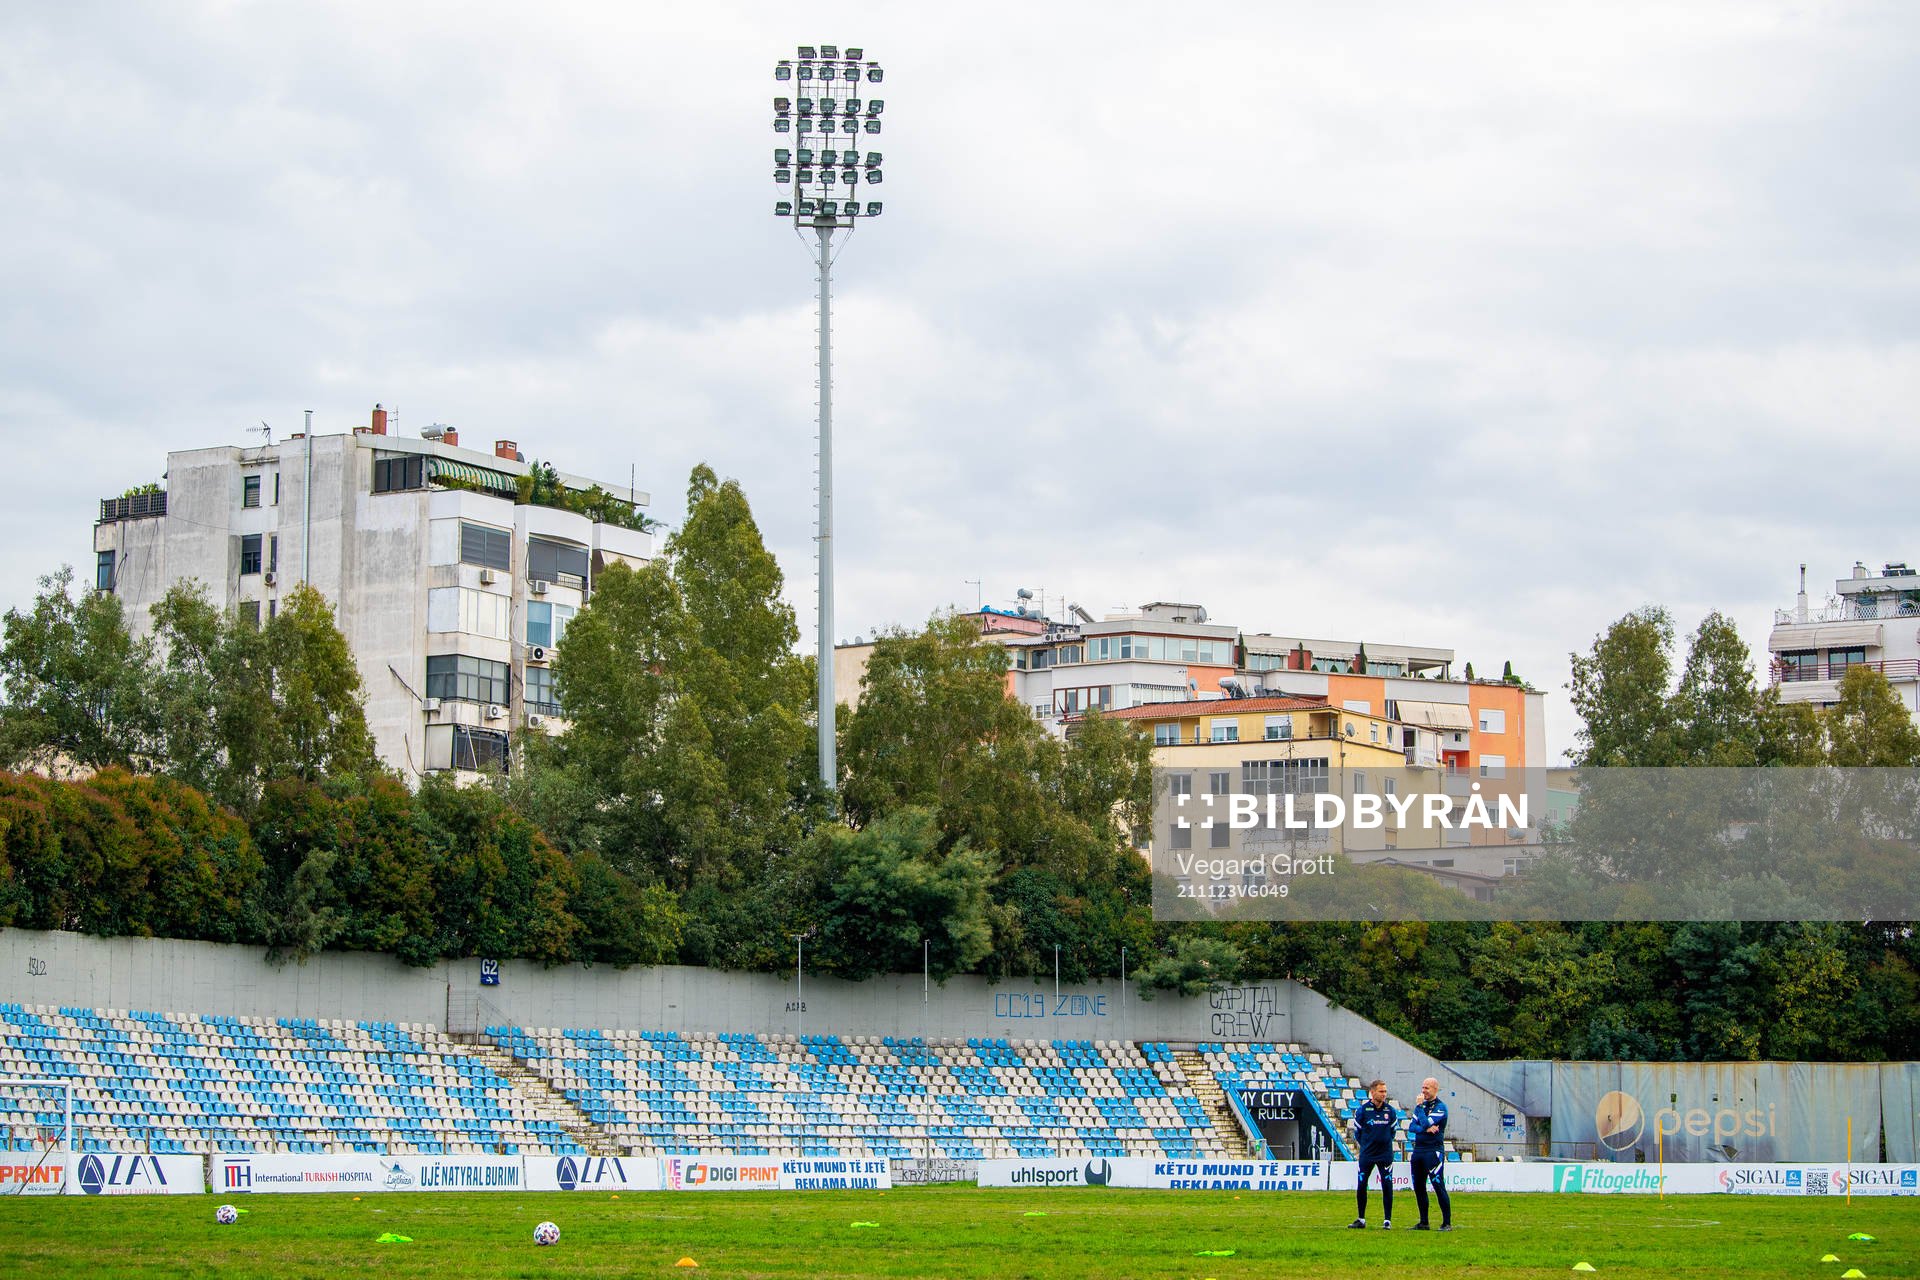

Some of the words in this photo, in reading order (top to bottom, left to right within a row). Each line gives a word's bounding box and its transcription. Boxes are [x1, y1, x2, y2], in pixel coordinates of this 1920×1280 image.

[482, 959, 498, 975] G2
[1052, 994, 1106, 1016] ZONE
[1209, 985, 1285, 1016] CAPITAL
[1211, 1011, 1274, 1038] CREW
[1261, 1091, 1294, 1107] CITY
[1258, 1108, 1295, 1120] RULES
[1653, 1102, 1776, 1145] pepsi
[0, 1166, 63, 1183] PRINT
[421, 1162, 440, 1187] UJË
[442, 1166, 484, 1186] NATYRAL
[485, 1166, 519, 1186] BURIMI
[710, 1167, 737, 1181] DIGI
[740, 1167, 779, 1181] PRINT
[783, 1159, 811, 1174] KËTU
[814, 1161, 846, 1173] MUND
[849, 1159, 862, 1173] TË
[864, 1159, 886, 1174] JETË
[1154, 1162, 1198, 1176] KËTU
[1202, 1164, 1254, 1176] MUND
[1259, 1162, 1278, 1176] TË
[1283, 1162, 1320, 1176] JETË
[255, 1172, 303, 1182] International
[305, 1172, 338, 1182] TURKISH
[339, 1172, 373, 1182] HOSPITAL
[795, 1177, 847, 1189] REKLAMA
[1011, 1167, 1078, 1186] uhlsport
[1453, 1174, 1487, 1185] Center
[1583, 1169, 1668, 1193] Fitogether
[1735, 1170, 1785, 1184] SIGAL
[1849, 1170, 1900, 1185] SIGAL
